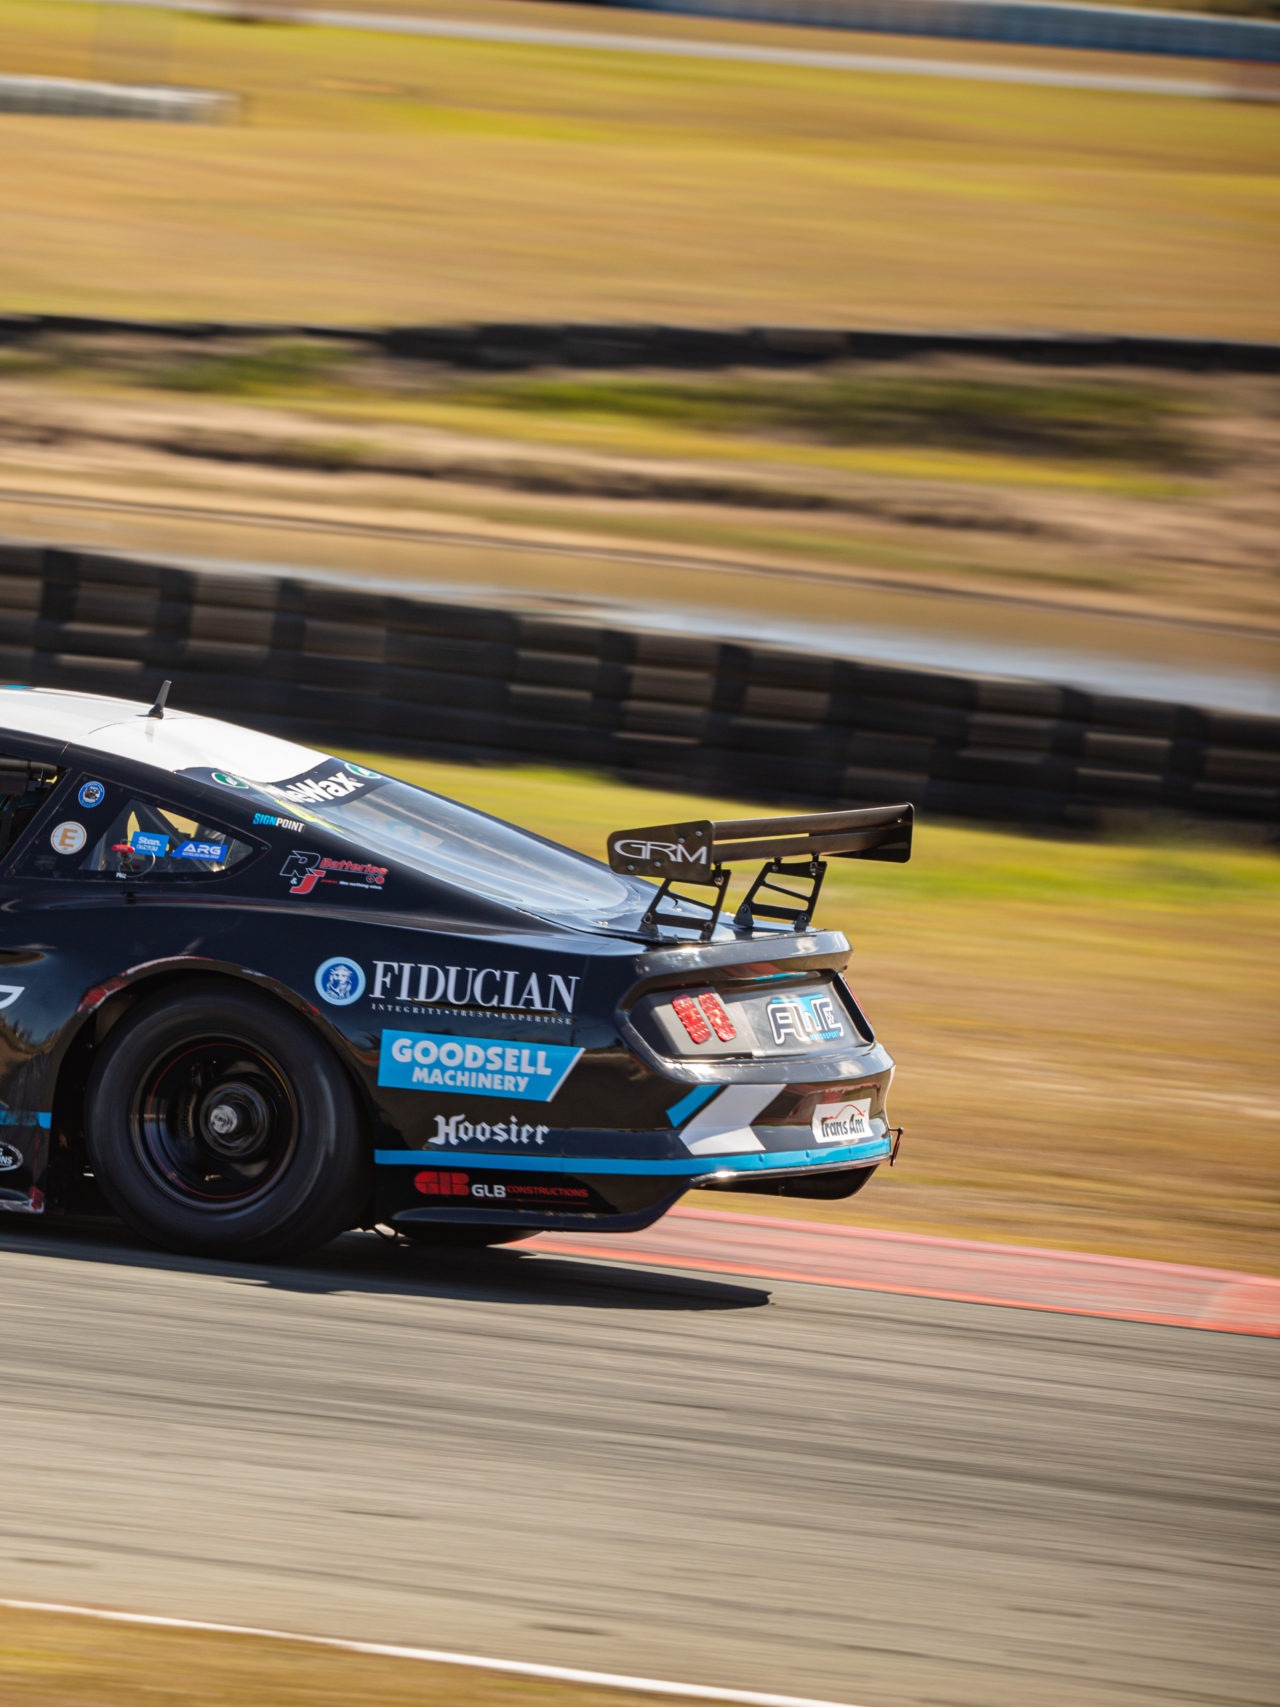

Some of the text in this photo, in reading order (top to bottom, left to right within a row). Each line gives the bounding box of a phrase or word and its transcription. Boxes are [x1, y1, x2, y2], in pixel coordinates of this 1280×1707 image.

[252, 812, 305, 833] SIGNPOINT
[59, 828, 78, 848] E
[183, 843, 222, 855] ARG
[613, 839, 708, 865] GRM
[320, 858, 388, 876] Batteries
[368, 960, 581, 1013] FIDUCIAN
[391, 1038, 552, 1076] GOODSELL
[412, 1066, 529, 1093] MACHINERY
[428, 1113, 550, 1146] Hoosier
[821, 1114, 865, 1137] Trans Am
[471, 1184, 589, 1198] GLB CONSTRUCTIONS
